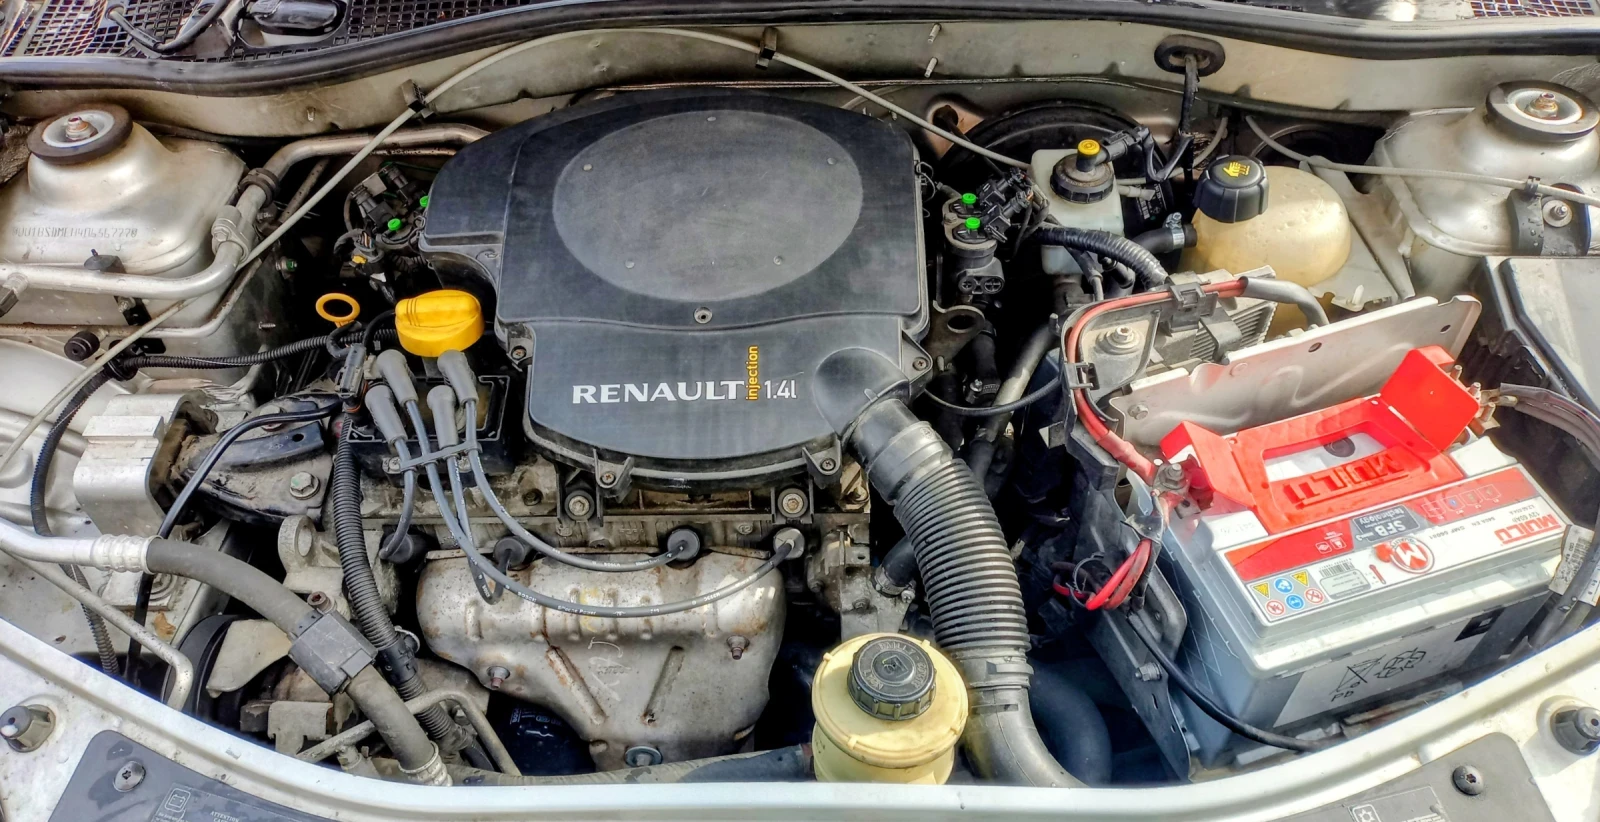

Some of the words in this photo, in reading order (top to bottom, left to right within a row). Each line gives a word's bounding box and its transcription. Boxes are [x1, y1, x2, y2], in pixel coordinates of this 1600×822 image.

[572, 380, 744, 404] RENAULT
[746, 345, 759, 400] injection
[1357, 505, 1405, 526] technology
[1527, 511, 1541, 519] 12V
[1372, 518, 1407, 538] SFB
[1494, 512, 1562, 545] MUTLU
